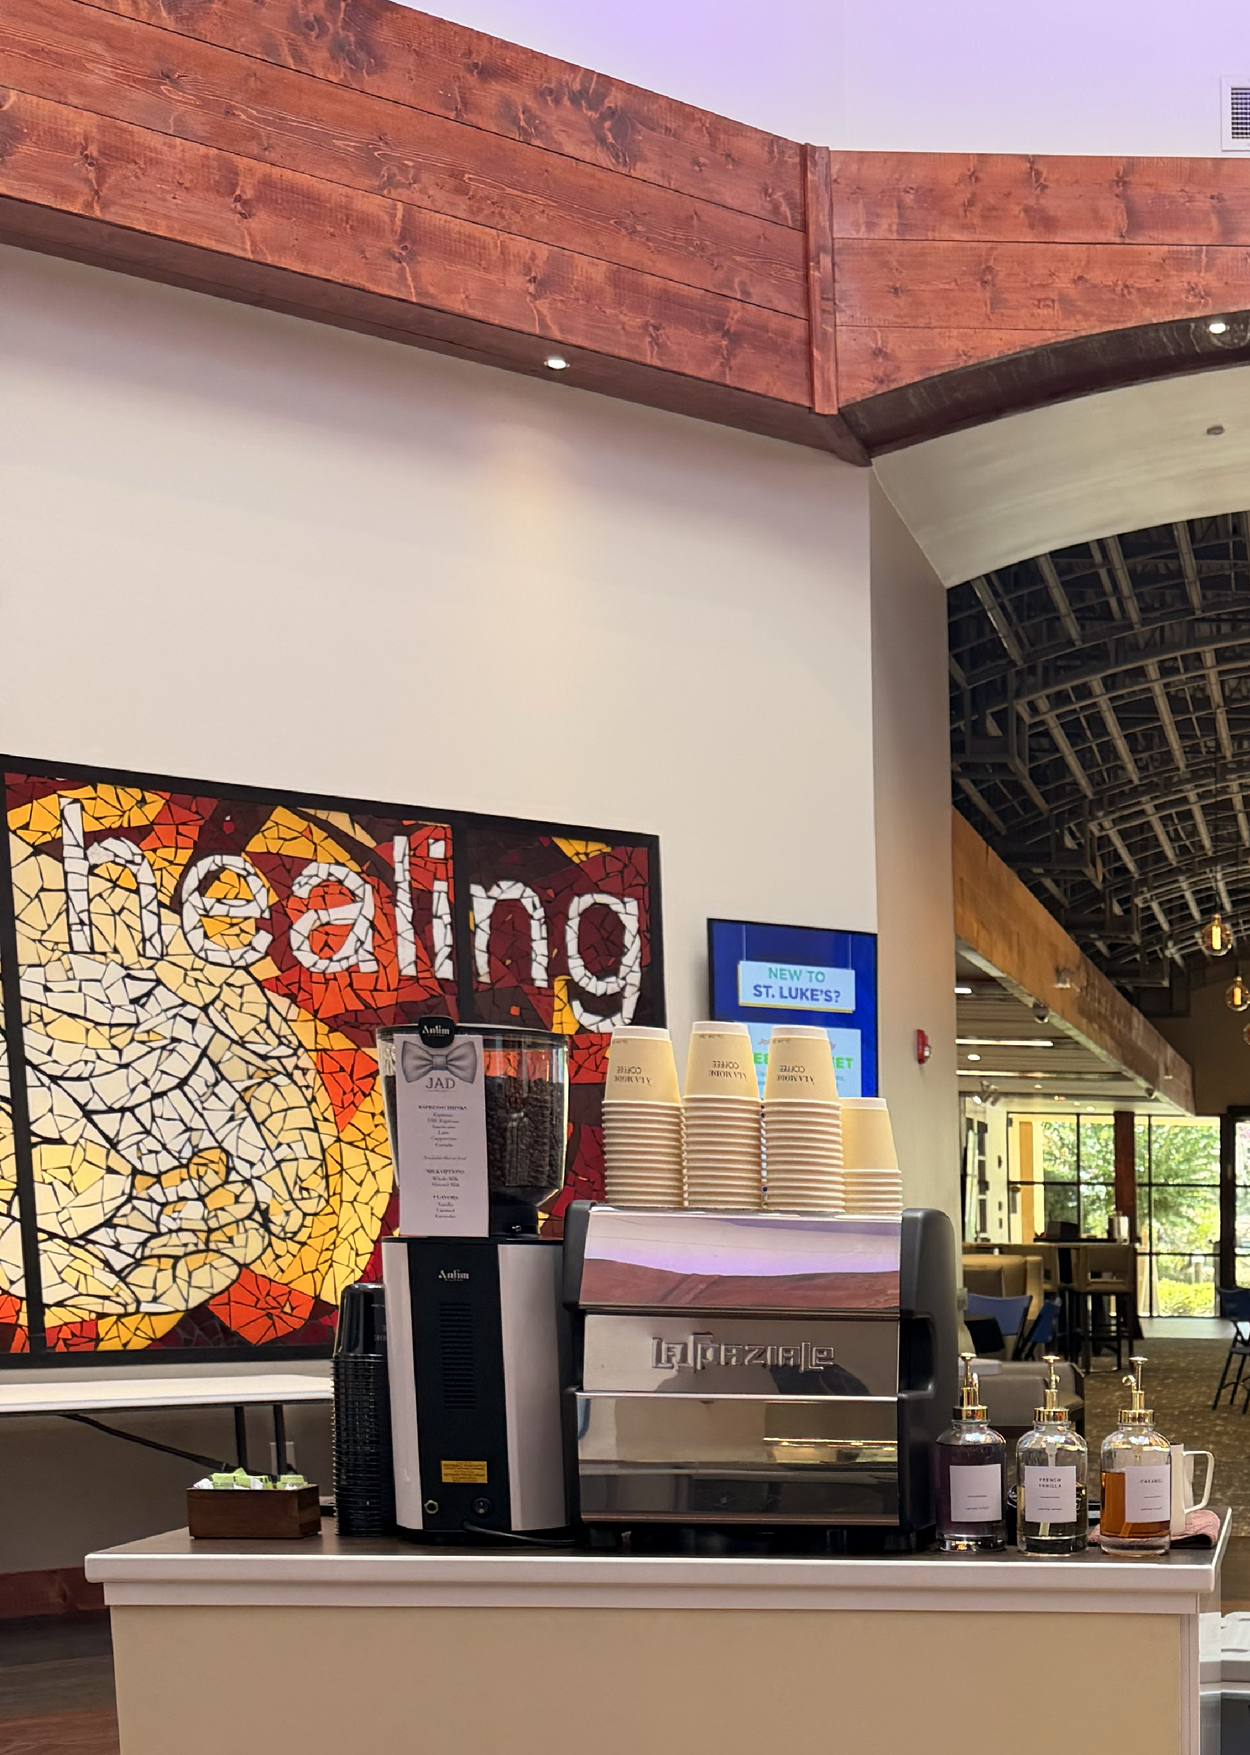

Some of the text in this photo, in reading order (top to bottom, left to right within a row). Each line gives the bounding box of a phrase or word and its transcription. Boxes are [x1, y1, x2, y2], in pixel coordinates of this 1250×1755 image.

[59, 797, 641, 1033] healing
[768, 968, 825, 983] NEW TO
[753, 984, 841, 1003] ST. LUKE'S?
[426, 1077, 455, 1089] JAD
